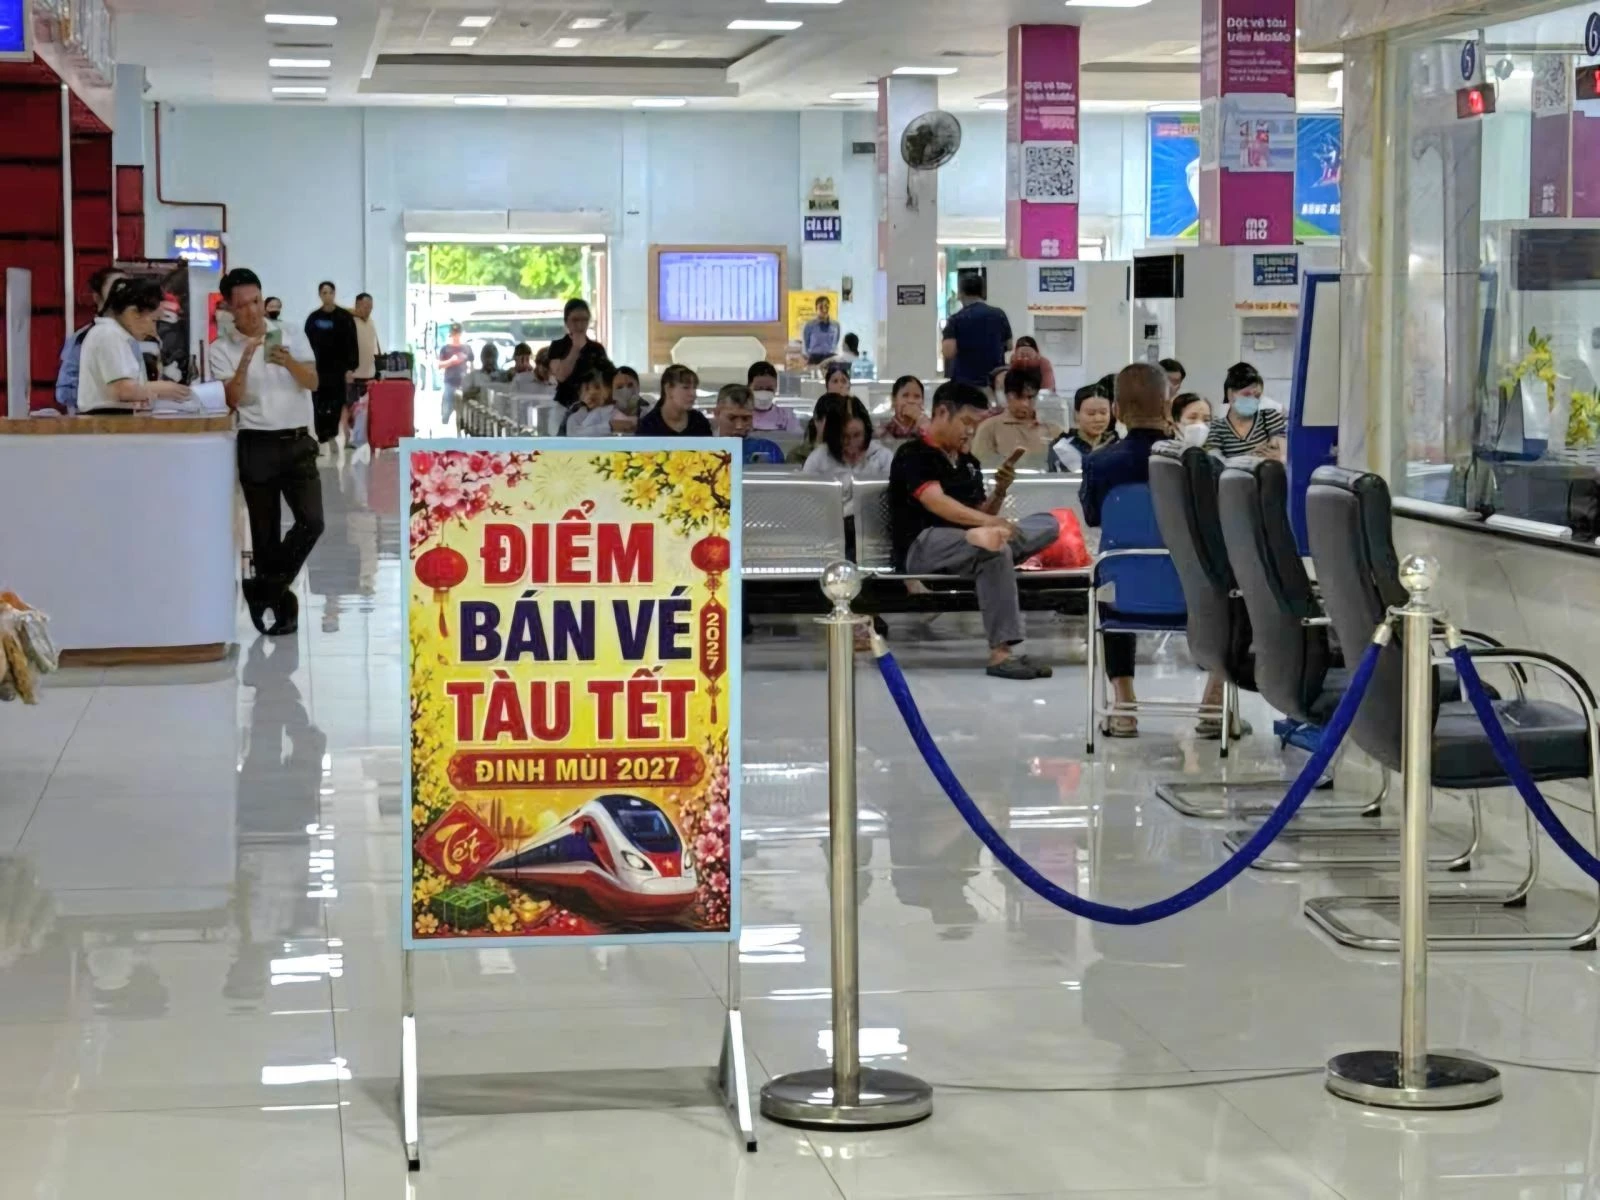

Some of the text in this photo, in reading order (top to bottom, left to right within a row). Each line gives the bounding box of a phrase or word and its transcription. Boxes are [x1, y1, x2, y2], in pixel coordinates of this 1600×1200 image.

[480, 499, 654, 584] ĐIỂM
[459, 586, 692, 662] BÁN VÉ
[705, 612, 720, 670] 2027
[447, 665, 696, 742] TÀU TẾT
[475, 754, 680, 783] ĐINH MÙI 2027
[435, 822, 481, 875] Tết
